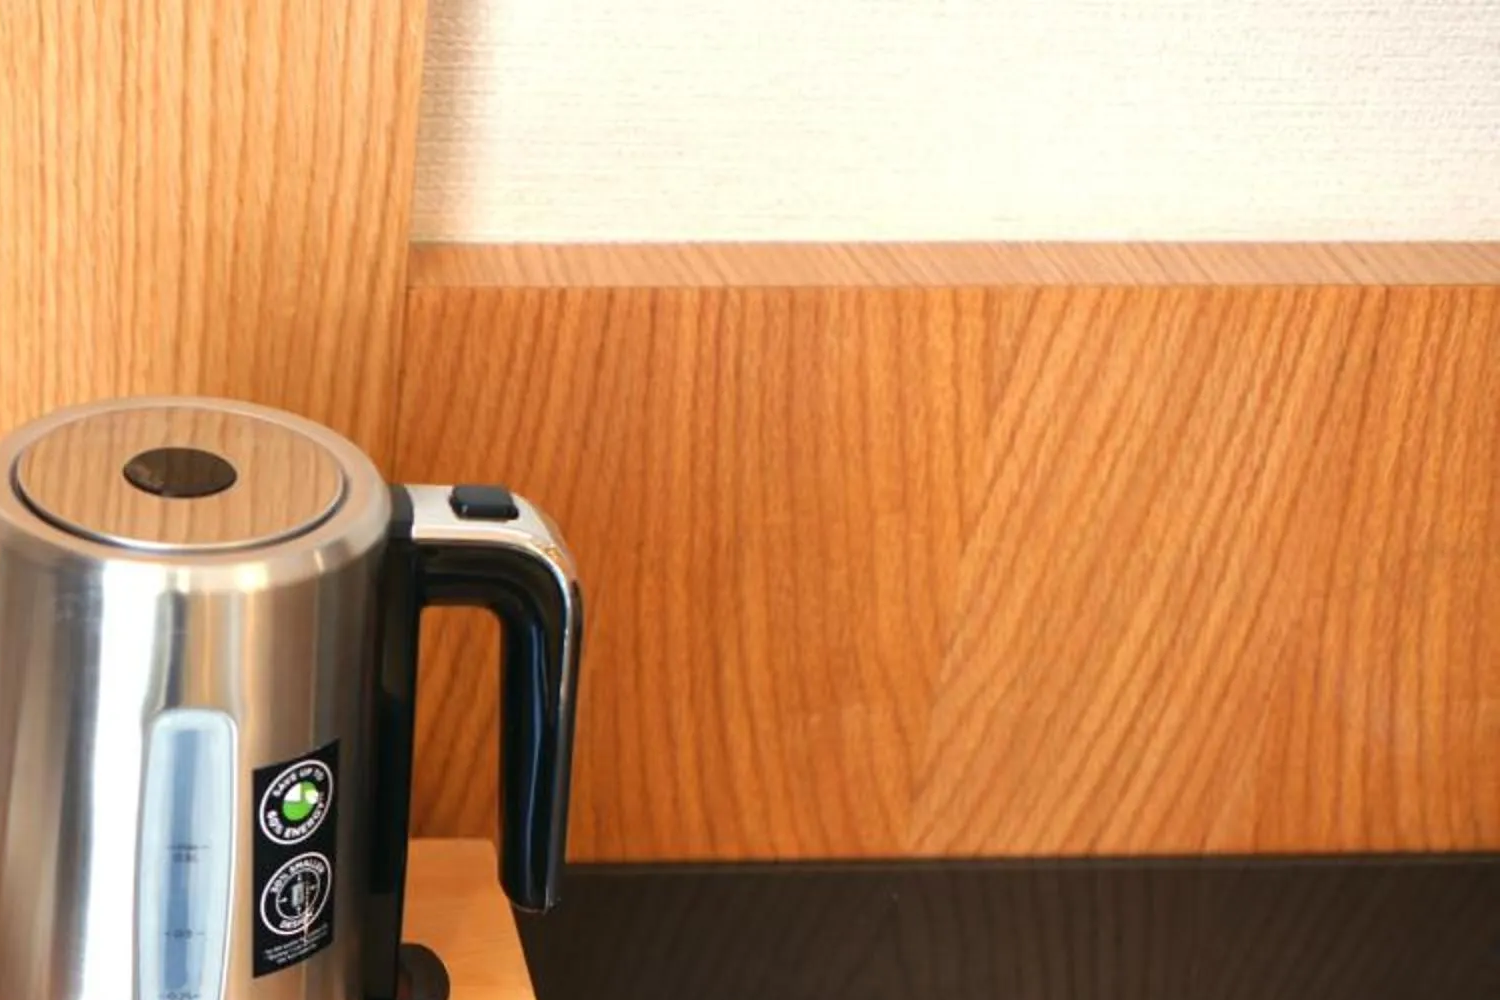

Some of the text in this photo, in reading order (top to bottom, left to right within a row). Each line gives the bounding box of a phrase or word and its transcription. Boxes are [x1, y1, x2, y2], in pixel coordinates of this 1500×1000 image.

[273, 773, 297, 797] SAVE
[299, 767, 313, 777] UP
[284, 792, 325, 838] ENERGY
